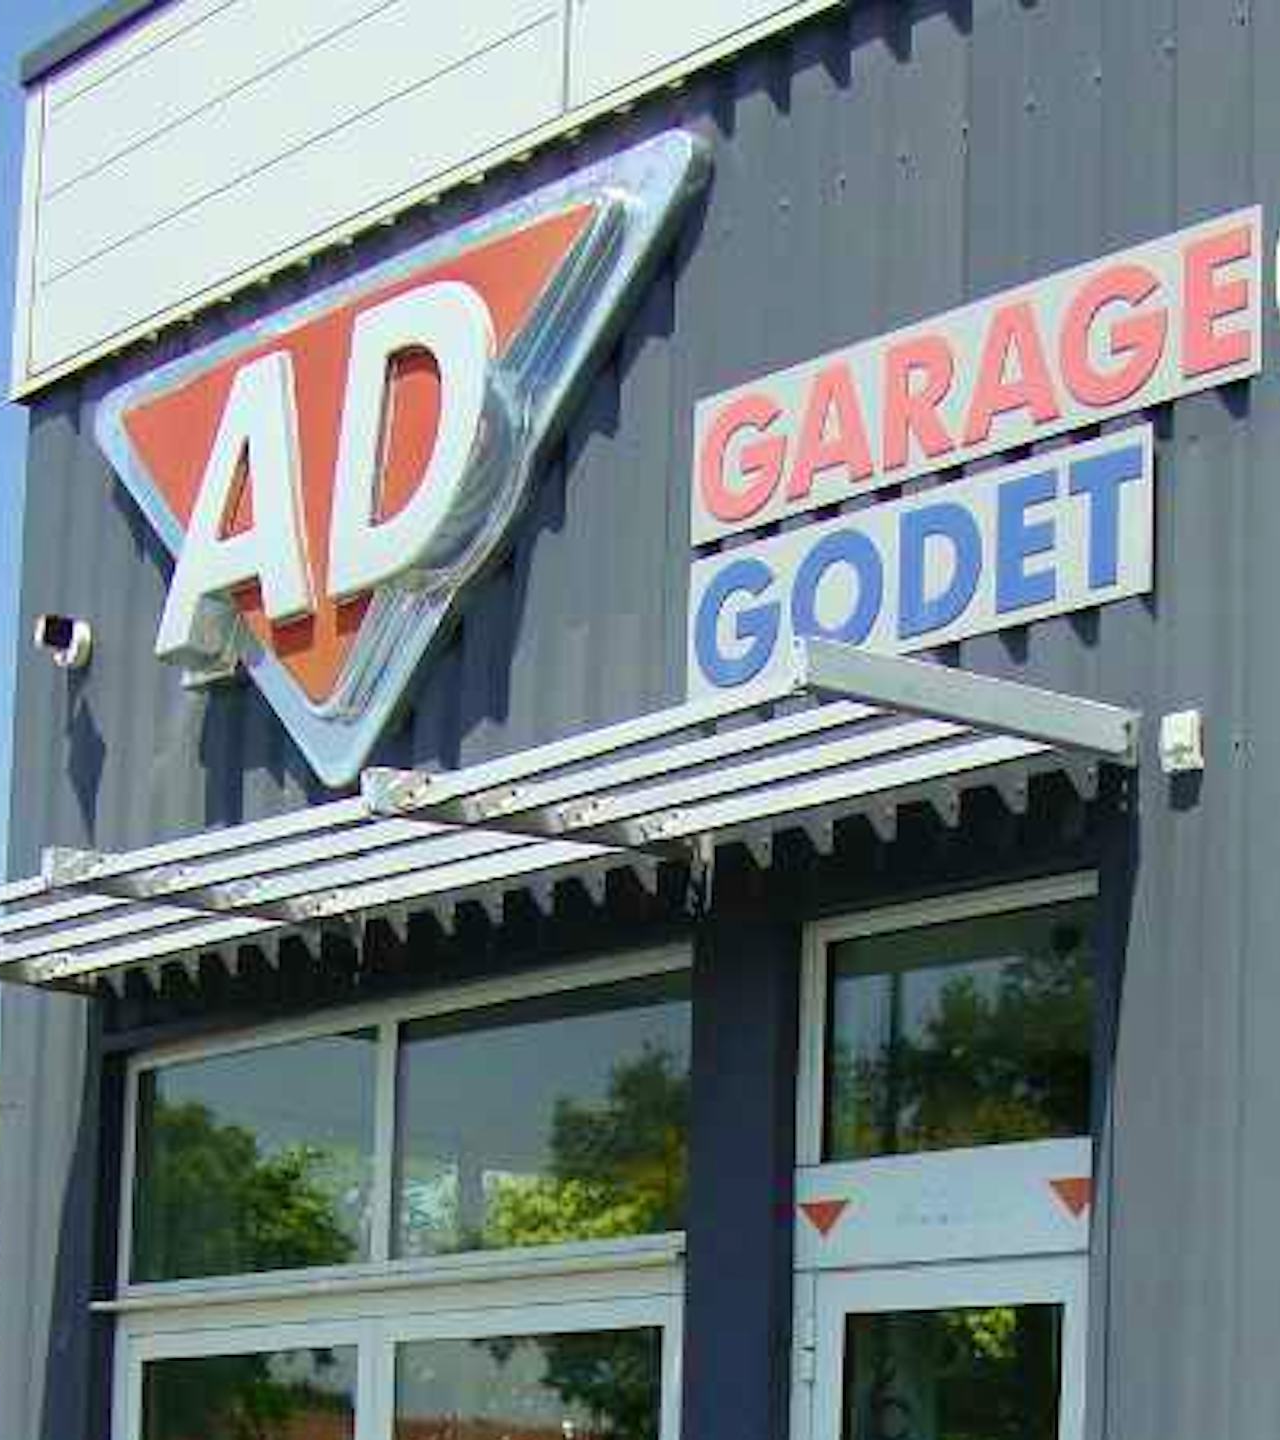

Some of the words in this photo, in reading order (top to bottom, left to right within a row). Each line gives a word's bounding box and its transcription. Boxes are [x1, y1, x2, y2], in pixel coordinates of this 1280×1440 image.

[155, 279, 500, 664] AD
[700, 224, 1253, 521] GARAGE
[694, 445, 1143, 688] GODET
